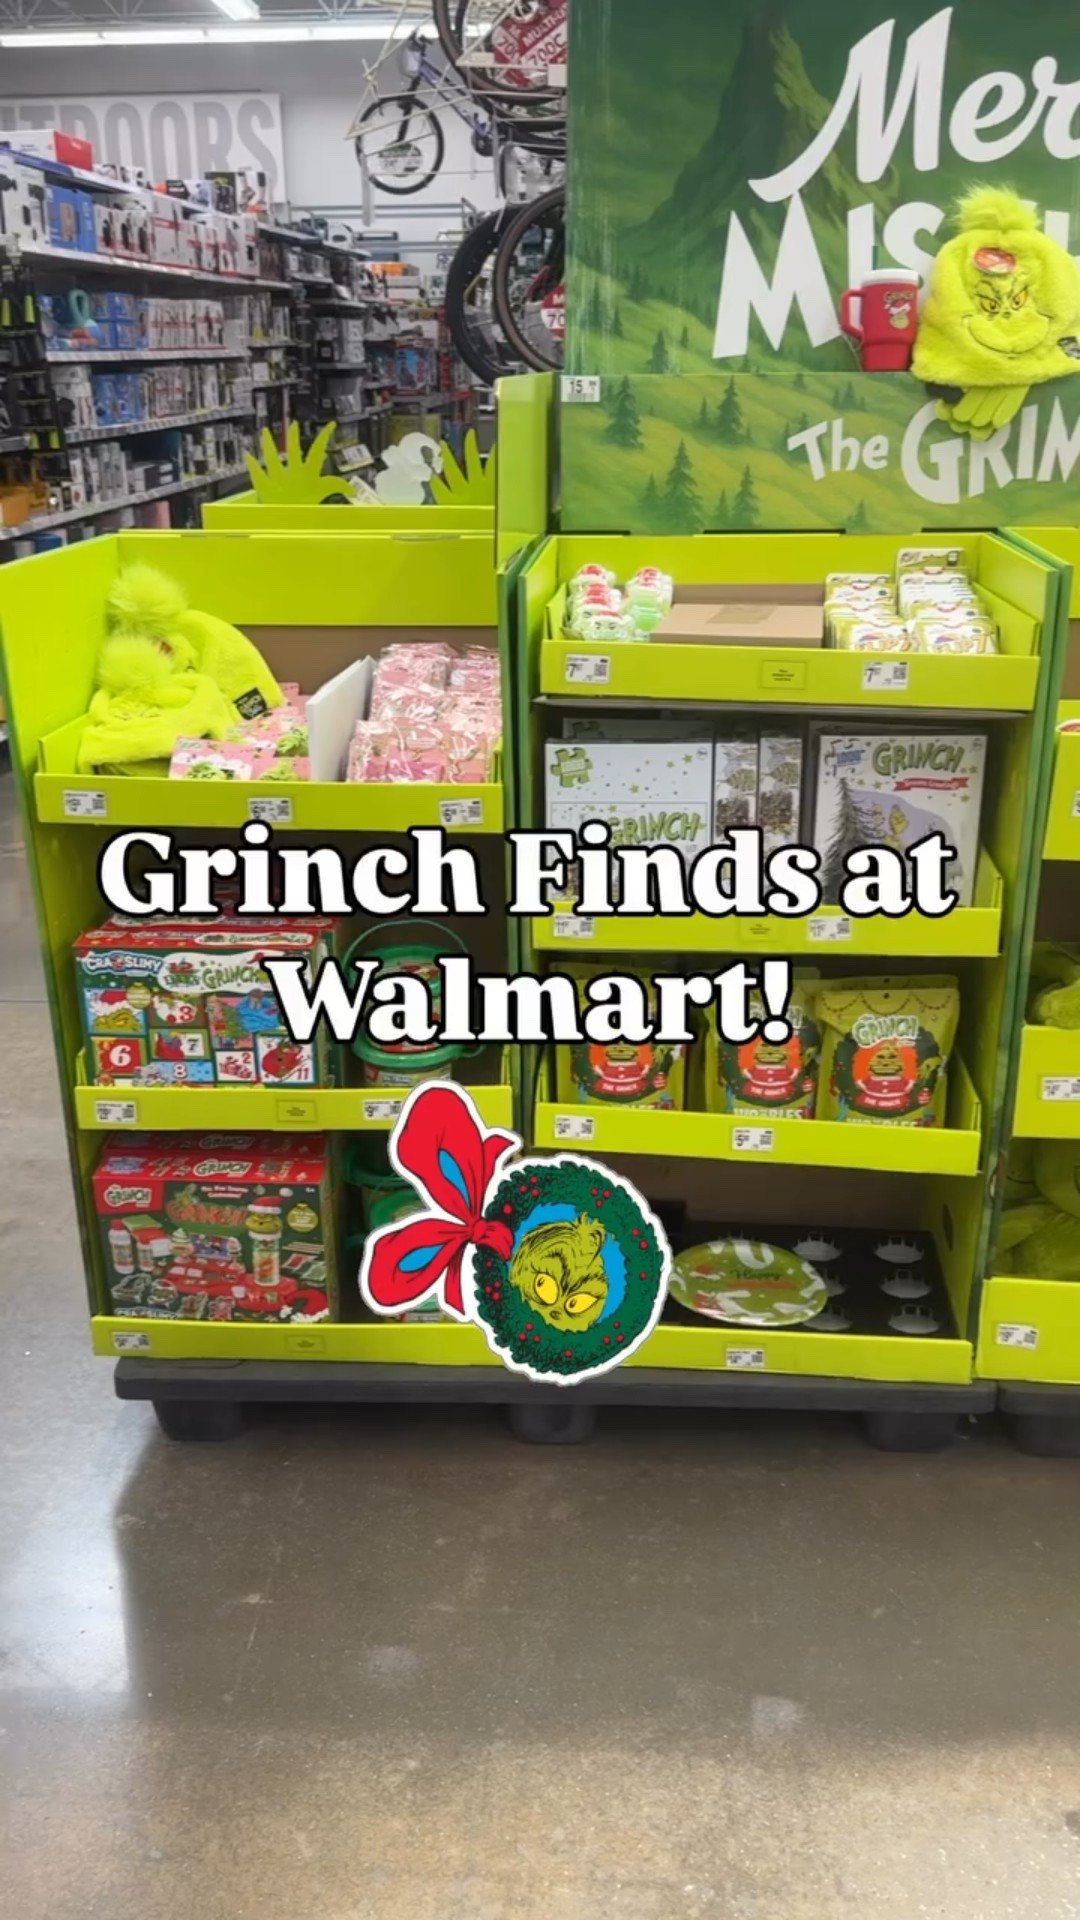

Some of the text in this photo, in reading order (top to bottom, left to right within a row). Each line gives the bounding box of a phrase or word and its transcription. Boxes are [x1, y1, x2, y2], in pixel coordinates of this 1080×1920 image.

[527, 32, 568, 67] 700C
[0, 98, 279, 199] TDOORS
[569, 379, 583, 394] 15
[787, 417, 889, 481] The
[871, 741, 967, 777] GRINCH
[179, 1006, 193, 1022] 3
[854, 1015, 919, 1047] GRINCH
[187, 1038, 200, 1052] 7
[109, 1045, 132, 1067] 6
[241, 1051, 252, 1065] 2
[173, 1063, 188, 1079] 8
[296, 1065, 310, 1081] 11
[195, 1161, 251, 1176] GRINCH
[105, 1186, 152, 1205] GRINCH
